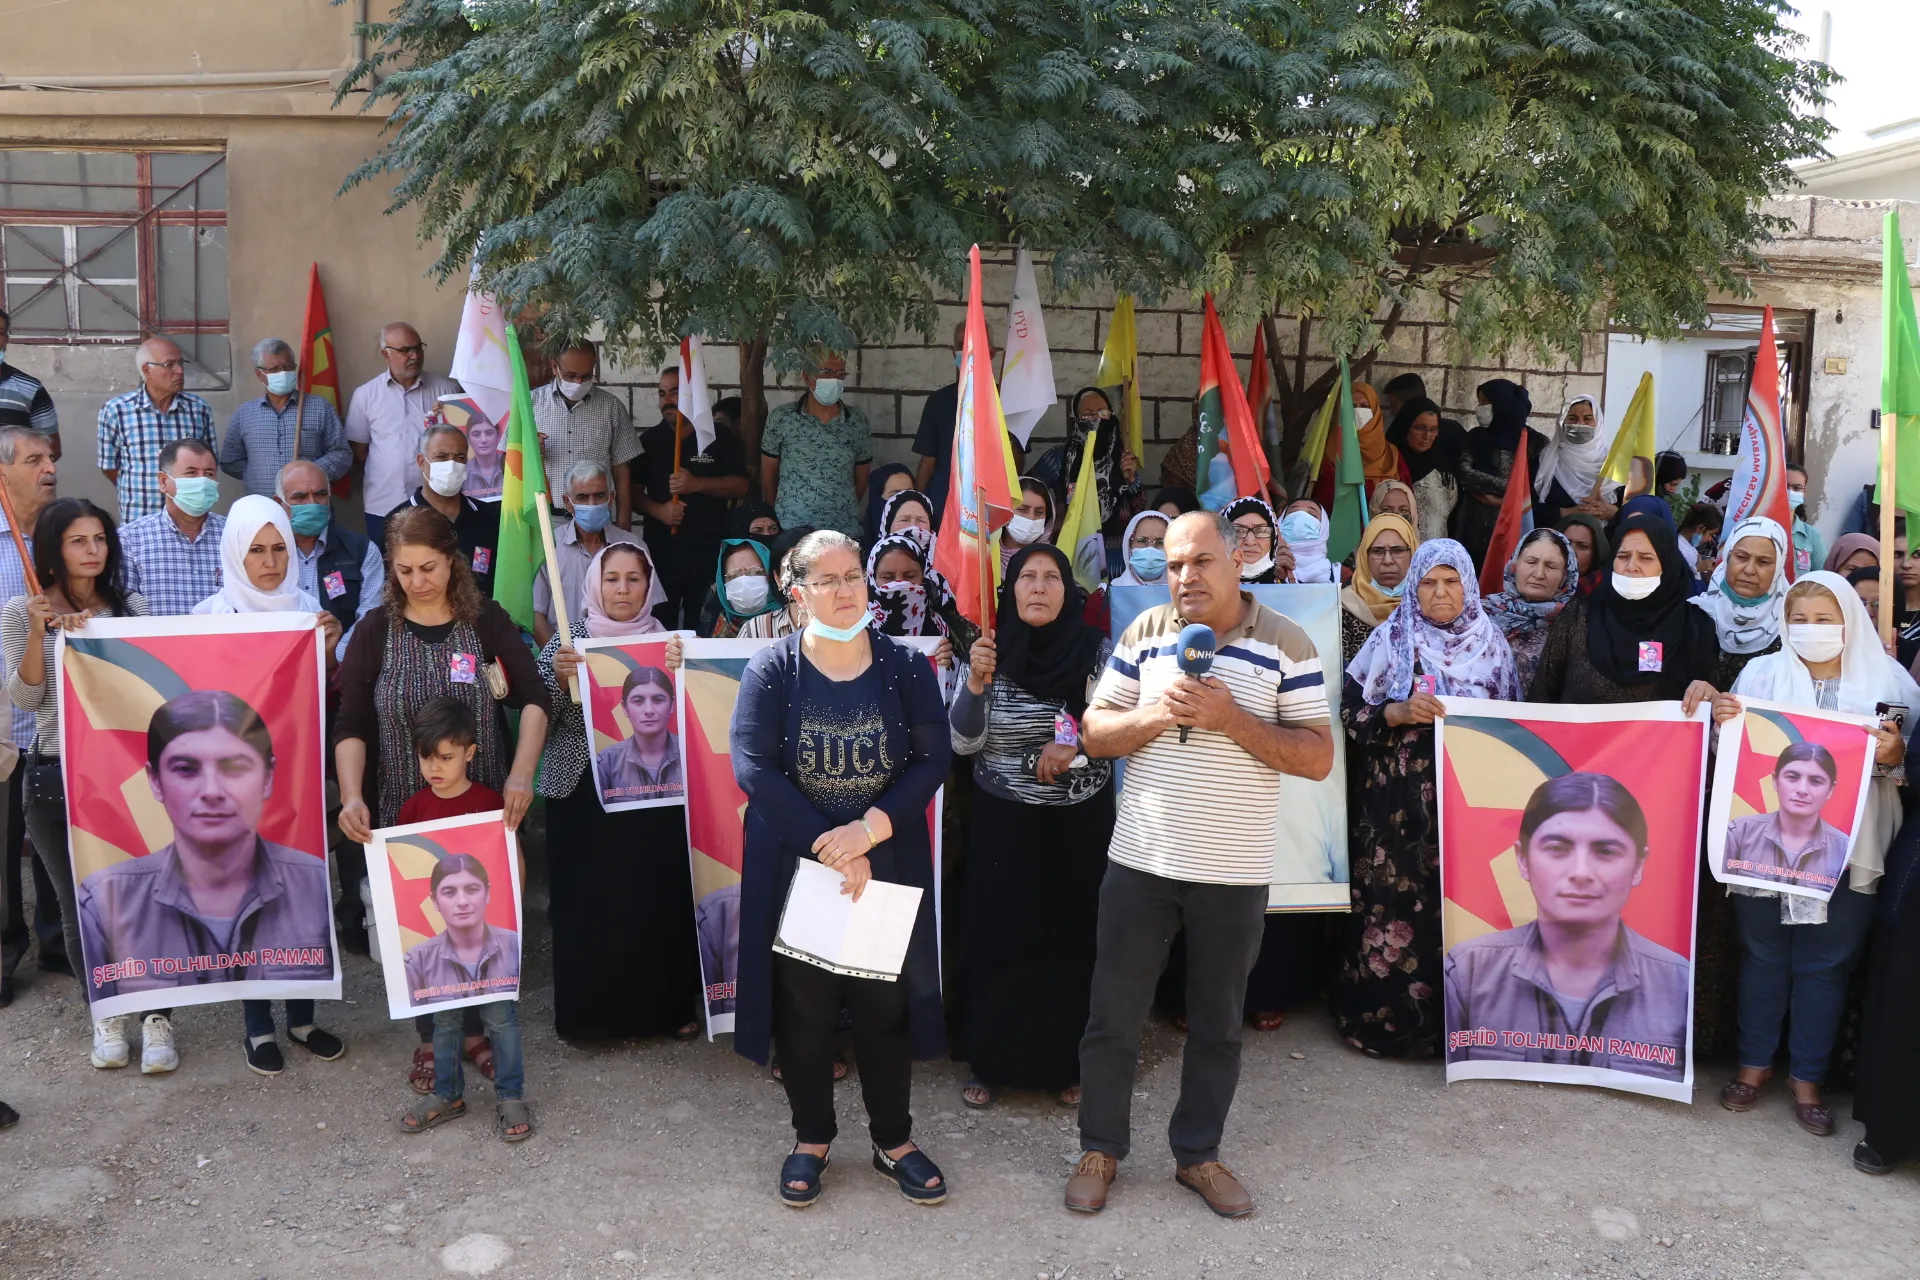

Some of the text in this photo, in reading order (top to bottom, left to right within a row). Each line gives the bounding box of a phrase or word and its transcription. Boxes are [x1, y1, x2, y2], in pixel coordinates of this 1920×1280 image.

[1013, 310, 1028, 339] PYD
[1754, 862, 1805, 880] TOLHILDAN
[93, 948, 324, 988] ŞEHÎD TOLHILDAN RAMAN
[441, 979, 490, 995] TOLHILDAN
[705, 978, 737, 1006] ŞEH
[1449, 1027, 1677, 1066] ŞEHÎD TOLHILDAN RAMAN
